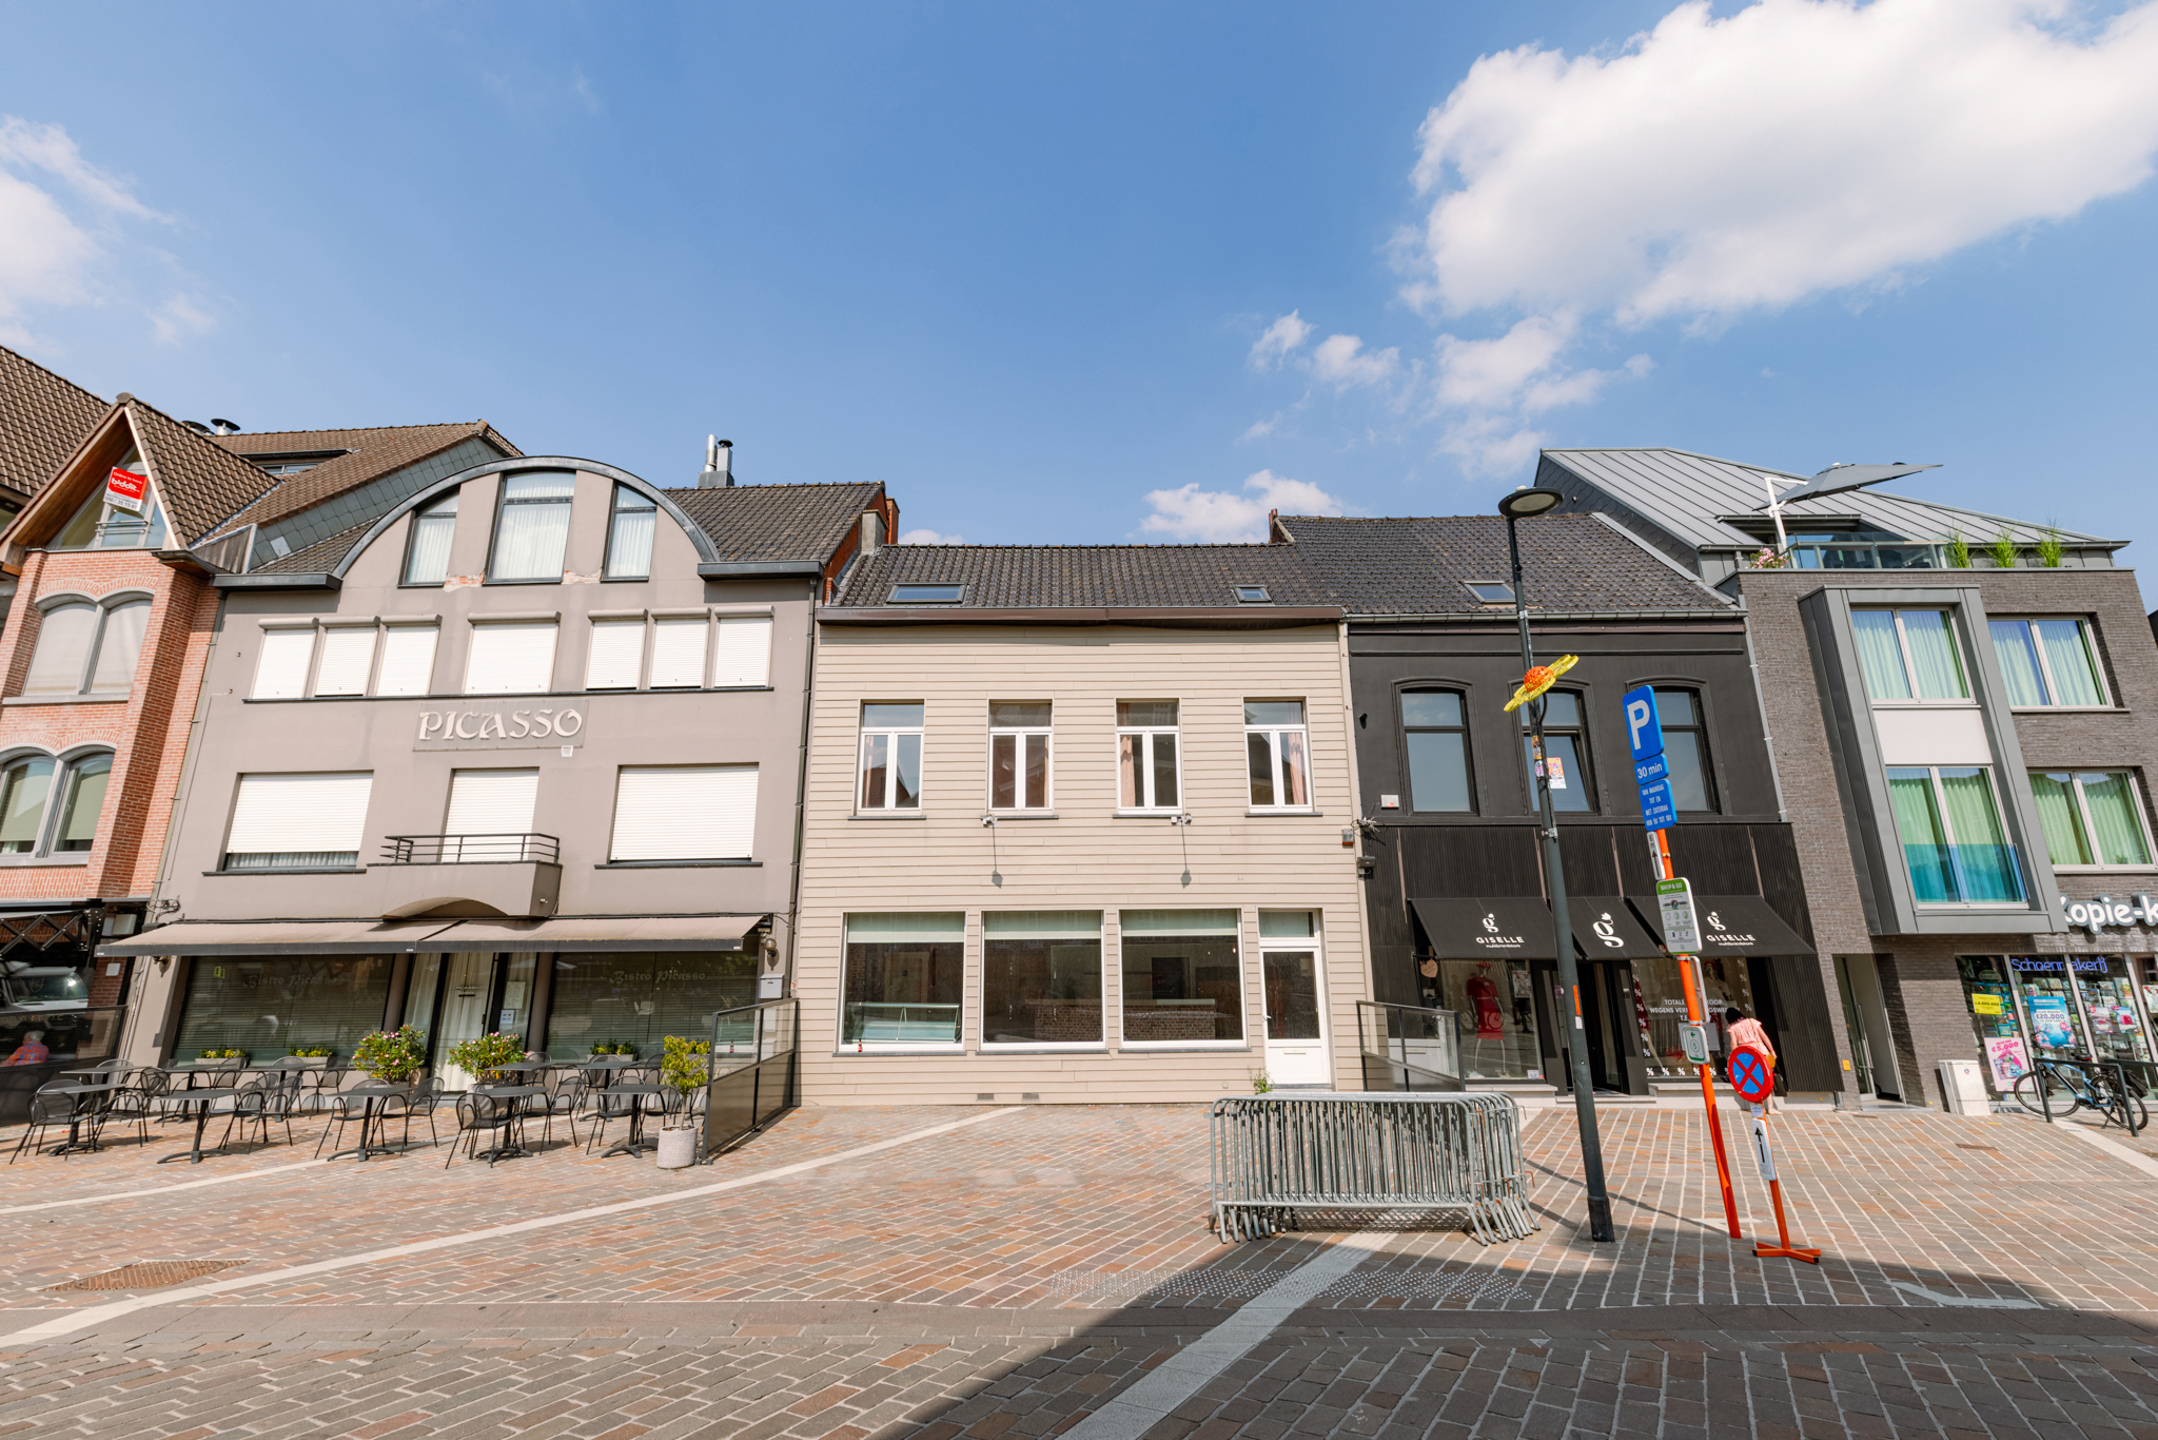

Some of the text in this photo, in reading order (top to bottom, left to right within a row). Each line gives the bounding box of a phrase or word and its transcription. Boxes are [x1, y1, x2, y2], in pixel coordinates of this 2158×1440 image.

[418, 708, 583, 741] PICASSO
[1627, 699, 1650, 750] P
[1637, 762, 1663, 779] 30 min
[2060, 895, 2158, 932] opie-k
[1476, 936, 1524, 944] GISELLE
[1706, 934, 1756, 942] GISELLE
